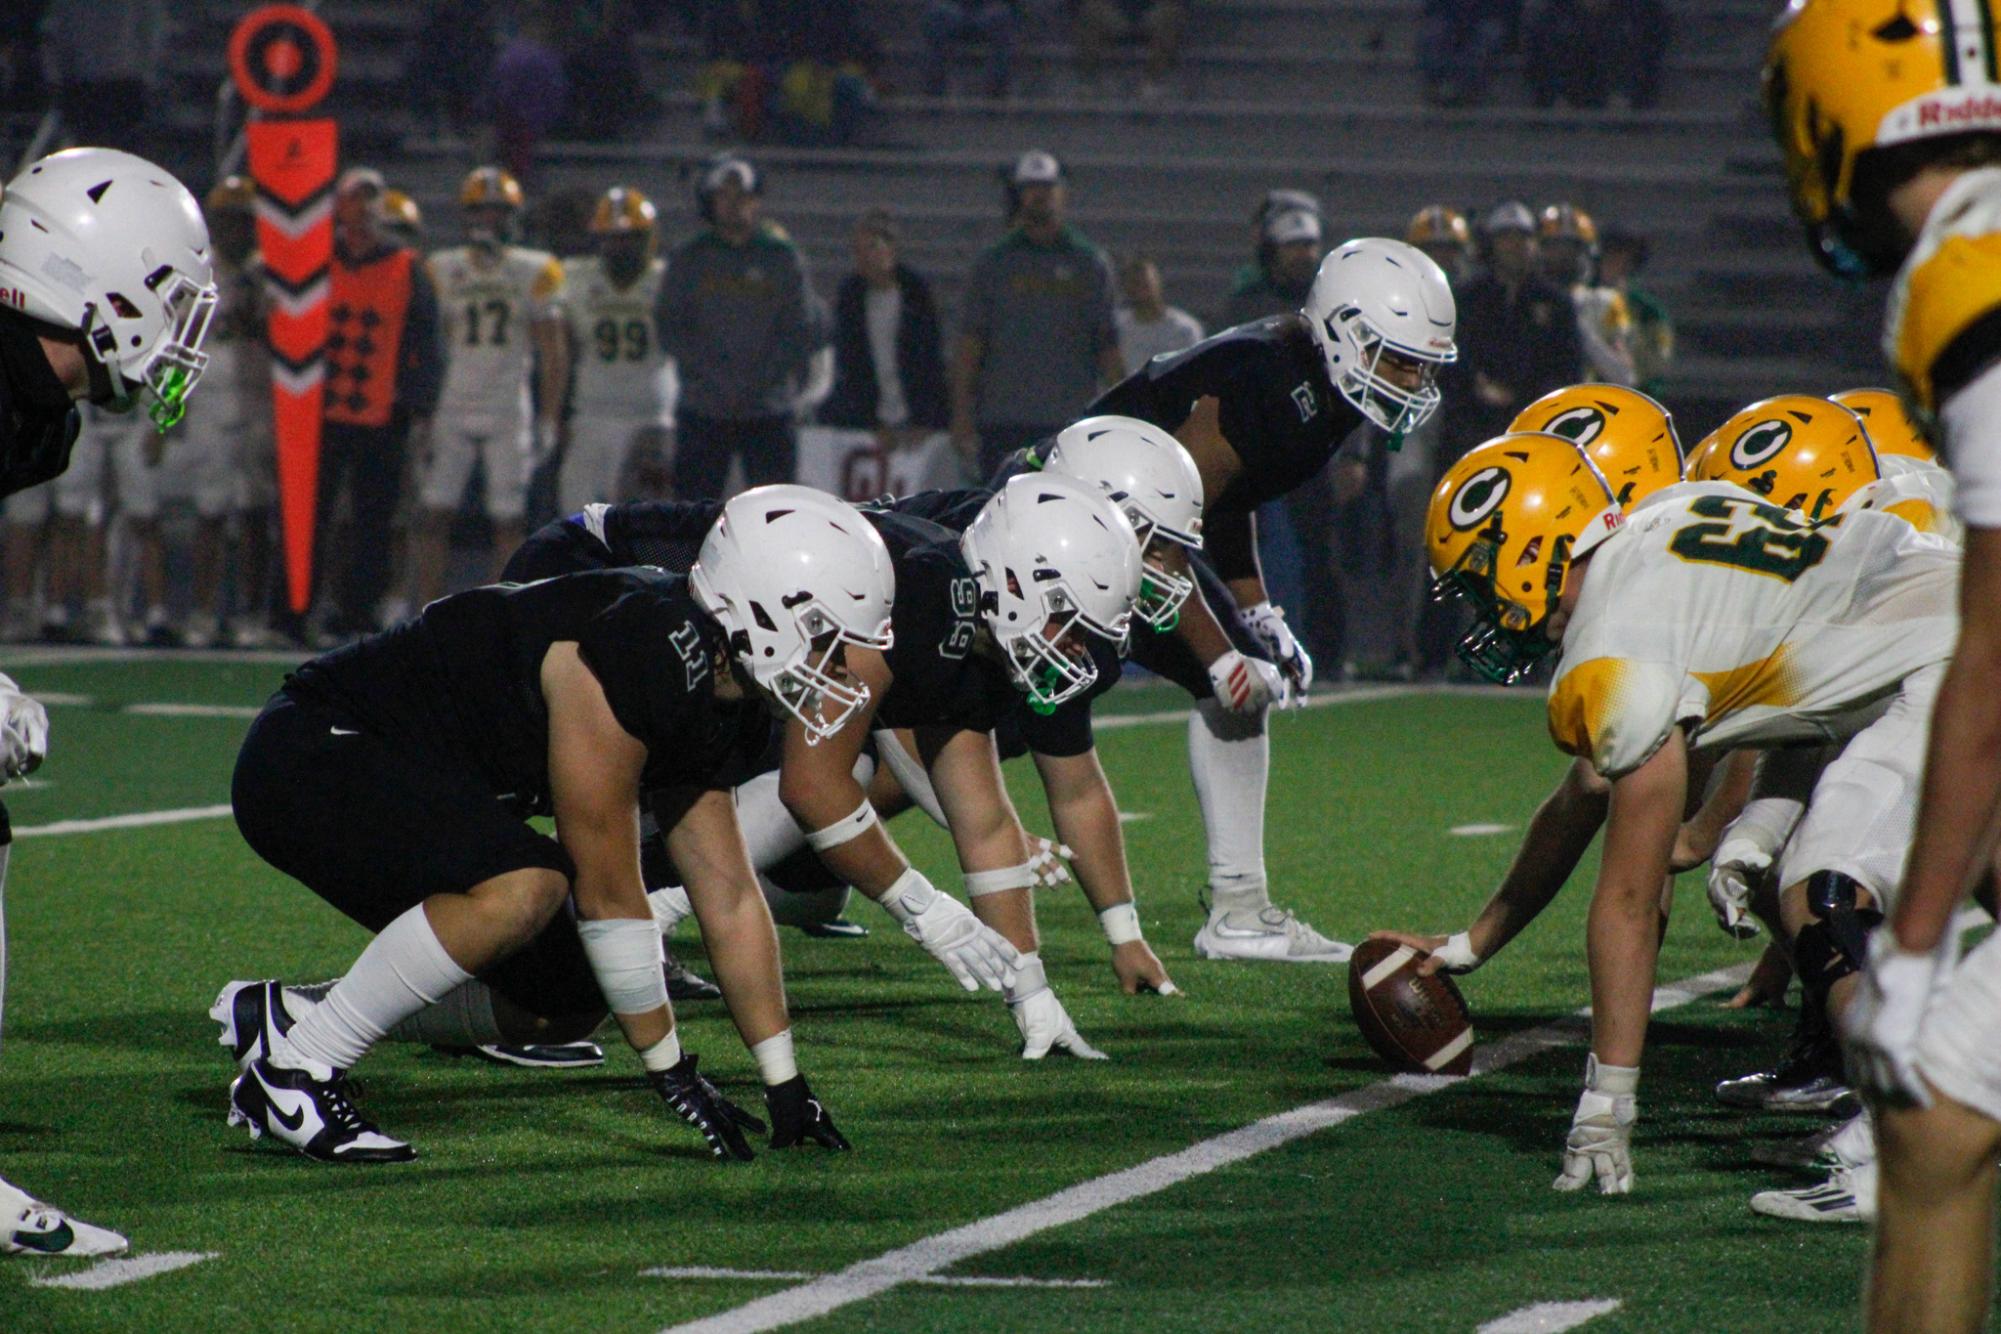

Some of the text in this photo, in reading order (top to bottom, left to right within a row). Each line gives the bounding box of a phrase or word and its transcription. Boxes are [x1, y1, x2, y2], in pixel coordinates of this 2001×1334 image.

[467, 300, 510, 345] 17
[595, 319, 649, 363] 99
[1730, 419, 1792, 470] C
[1448, 466, 1511, 532] C
